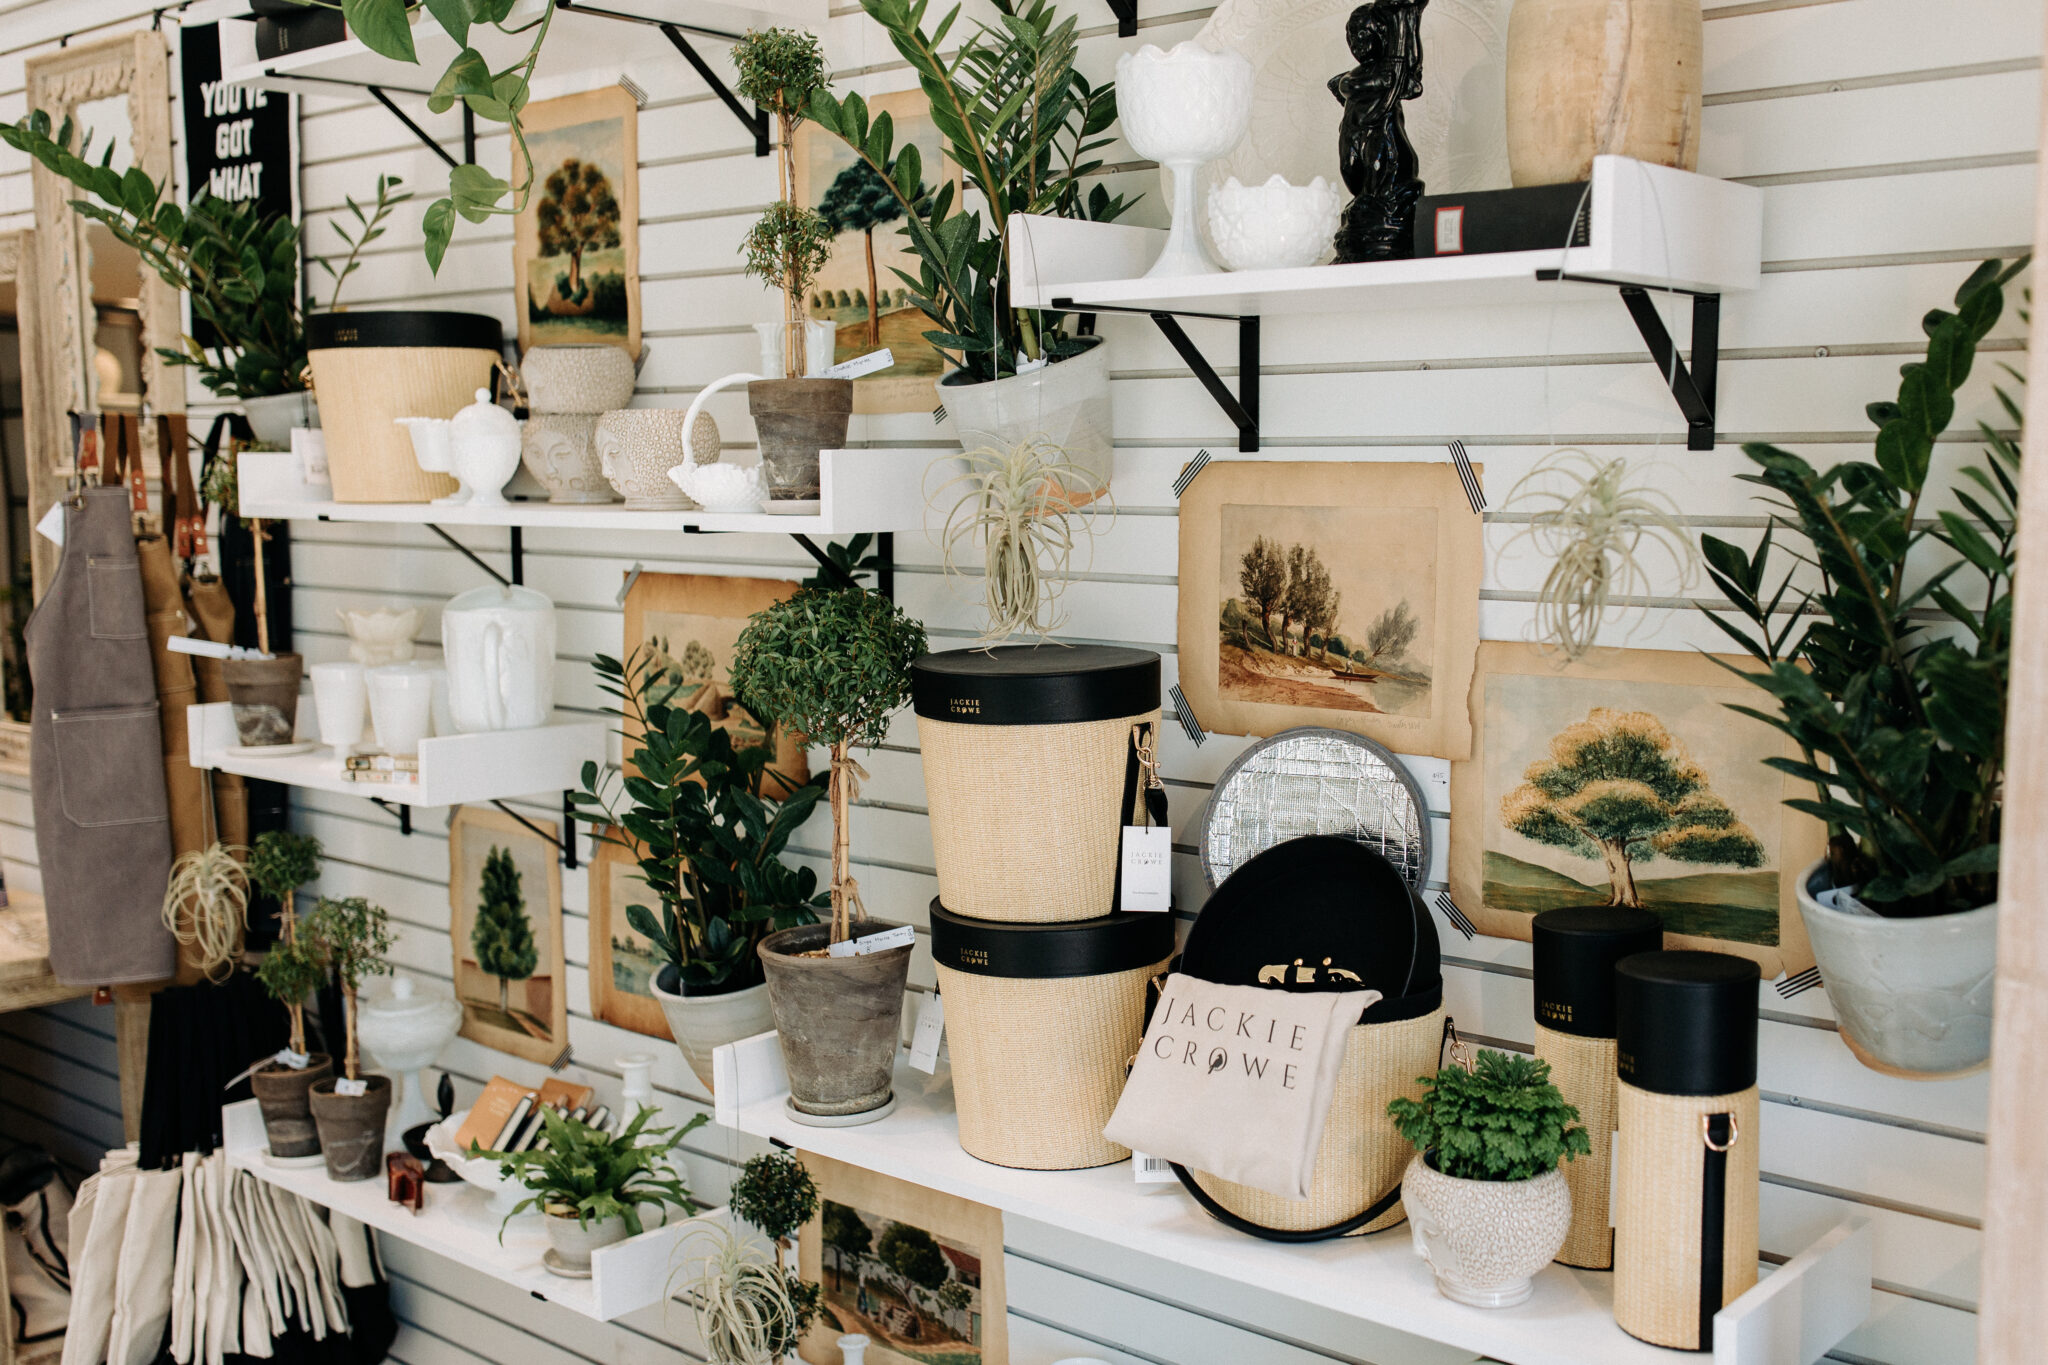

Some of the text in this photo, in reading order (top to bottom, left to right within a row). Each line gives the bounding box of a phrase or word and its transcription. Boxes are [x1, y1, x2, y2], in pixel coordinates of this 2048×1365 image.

[200, 80, 268, 118] YOUVE
[215, 118, 254, 160] GOT
[209, 161, 263, 203] WHAT
[950, 698, 980, 706] JACKIE
[950, 705, 981, 714] CROWE
[1131, 858, 1162, 866] CROWE
[960, 947, 988, 958] JACKIE
[960, 955, 989, 966] CROWE
[1162, 997, 1307, 1051] JACKIE
[1154, 1035, 1298, 1090] CROWE
